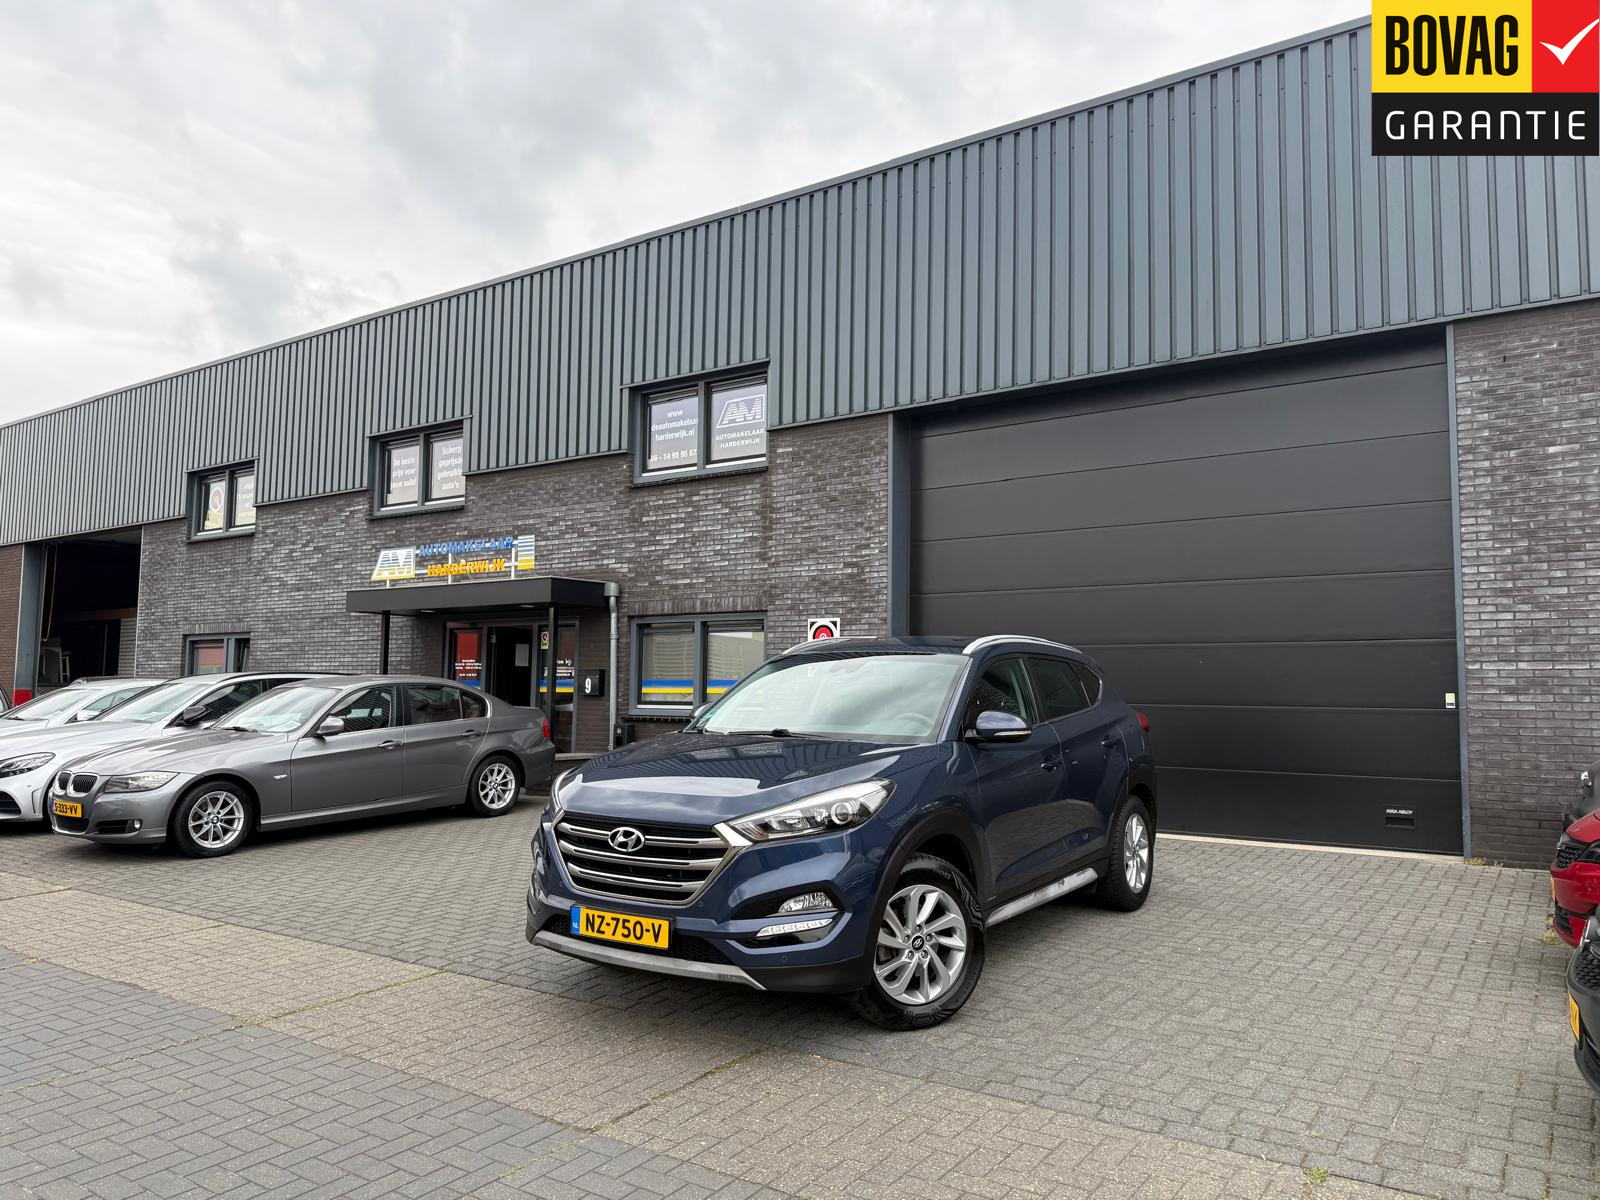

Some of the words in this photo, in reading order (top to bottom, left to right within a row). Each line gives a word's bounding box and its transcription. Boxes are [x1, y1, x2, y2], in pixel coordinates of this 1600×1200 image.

[655, 428, 695, 442] harderwijk.nl
[720, 437, 761, 448] HARDERWIJK
[419, 536, 513, 557] AUTOMAKELAAR
[427, 558, 505, 577] HARDERWIJK
[585, 677, 592, 693] 9
[585, 912, 662, 943] NZ-750-V
